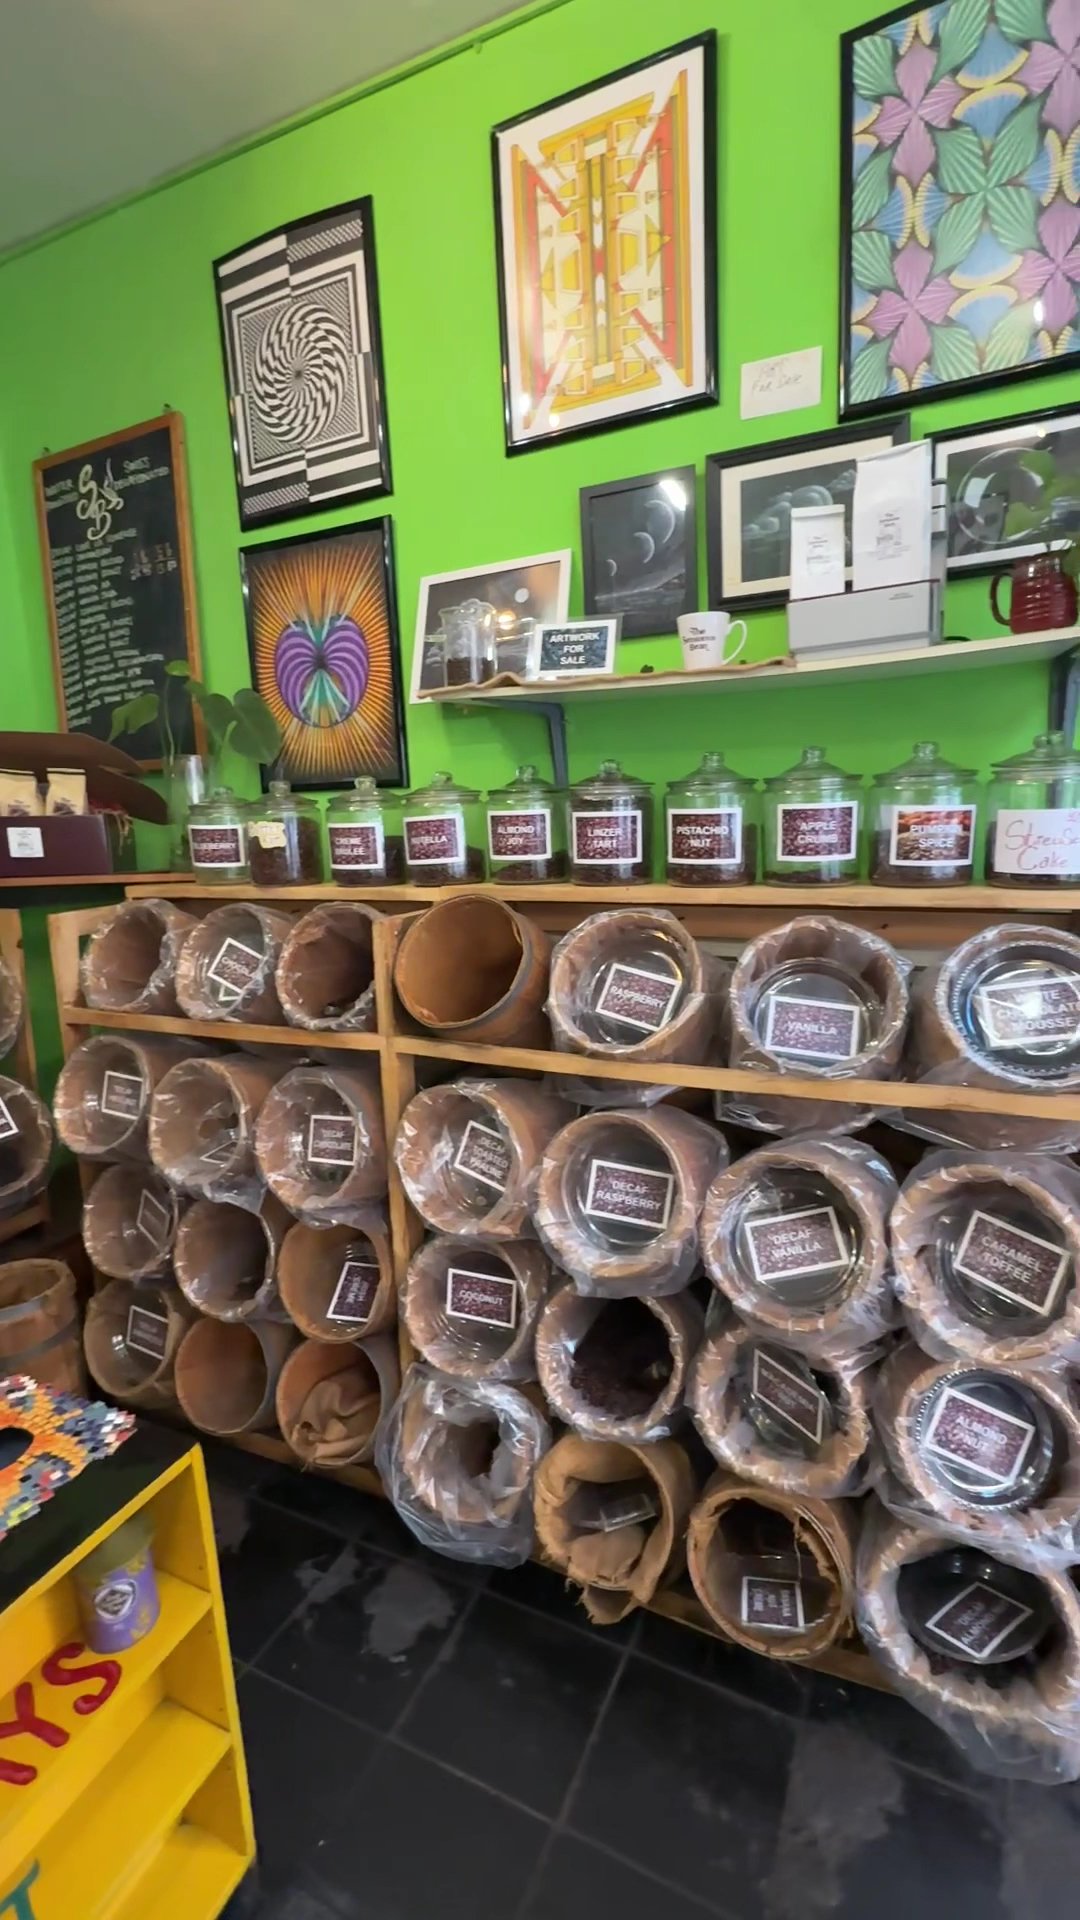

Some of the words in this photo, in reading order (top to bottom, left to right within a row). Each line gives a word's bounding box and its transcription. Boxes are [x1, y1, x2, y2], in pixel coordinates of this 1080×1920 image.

[550, 632, 600, 643] ARTWORK
[563, 645, 585, 653] FOR
[560, 656, 586, 665] SALE
[497, 825, 535, 834] ALMOND
[676, 826, 729, 835] PISTACHIO
[800, 821, 837, 831] APPLE
[588, 827, 623, 837] LINZER
[506, 837, 524, 846] JOY
[592, 839, 617, 848] TART
[690, 839, 712, 847] NUT
[797, 835, 838, 844] CRUMB
[919, 838, 954, 848] SPICE
[1017, 846, 1069, 871] Cake
[611, 1180, 648, 1194] DECAF
[595, 1190, 662, 1210] RASPBERRY
[773, 1228, 813, 1245] DECAF
[771, 1241, 823, 1259] VANILLA
[981, 1236, 1042, 1273] CARAMEL
[983, 1251, 1032, 1284] TOFFEE
[459, 1289, 504, 1306] COCONUT
[955, 1415, 1008, 1445] ALMOND
